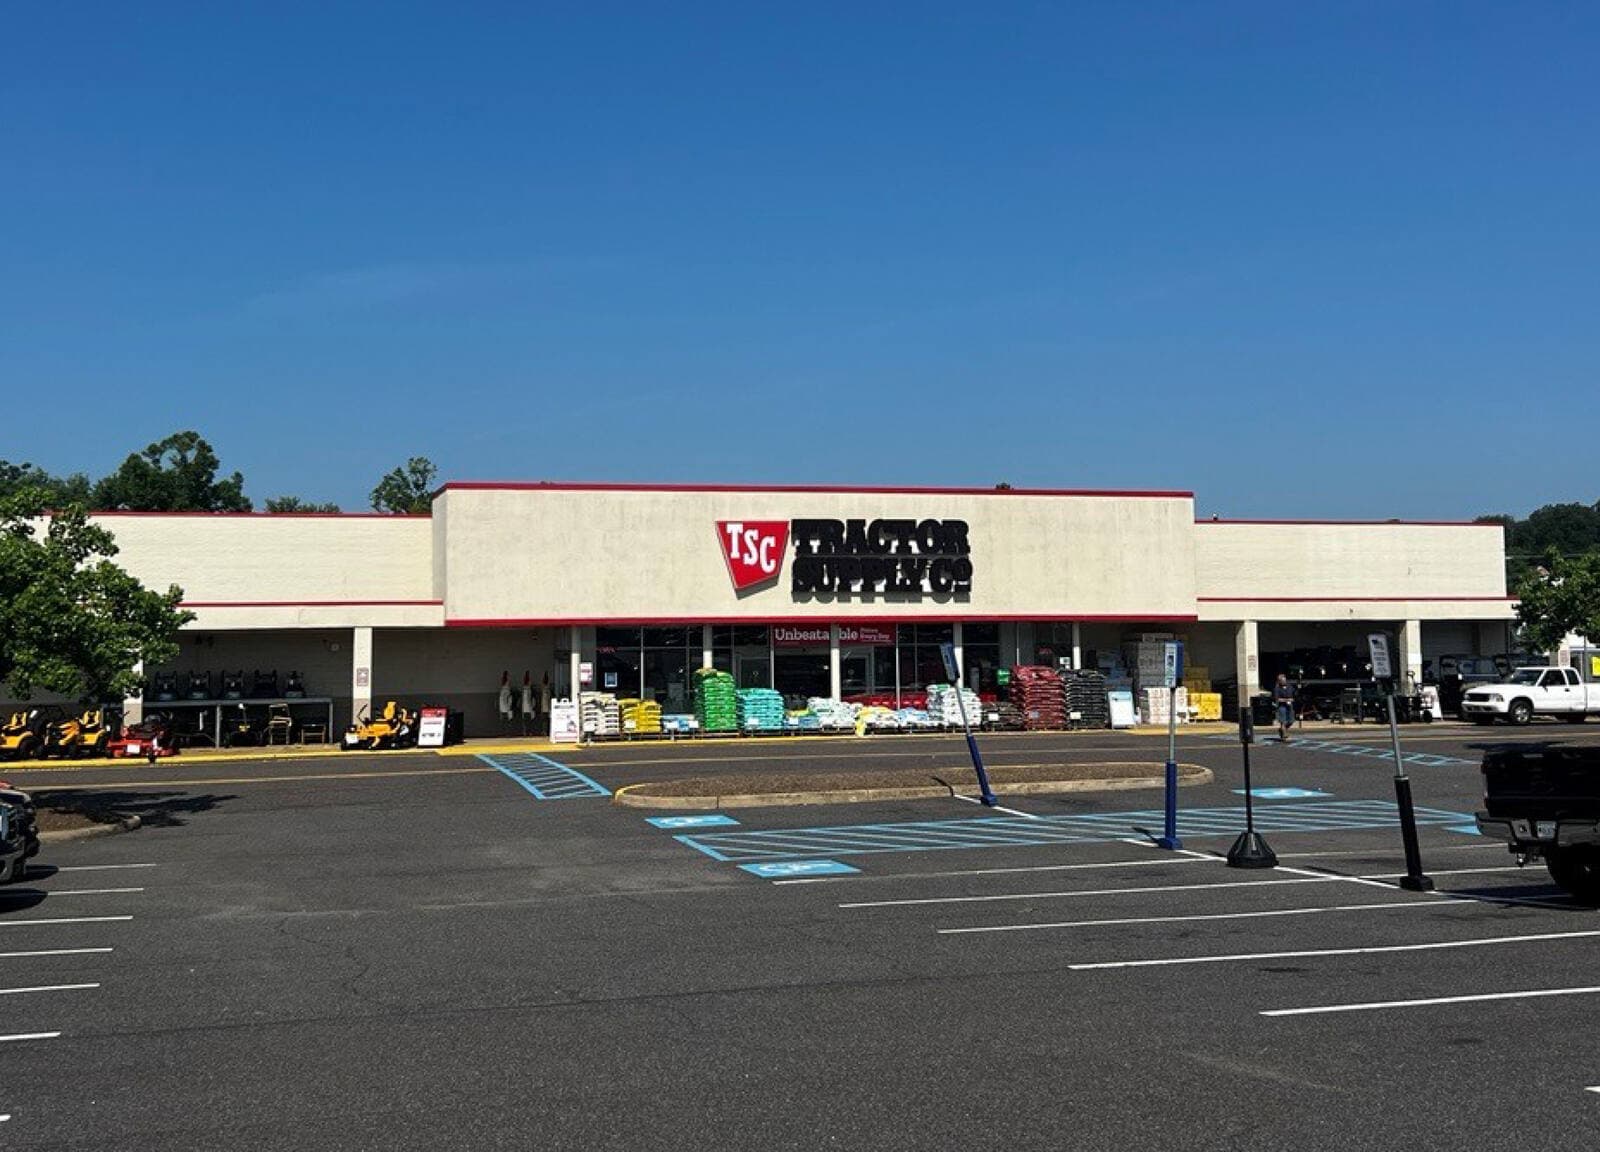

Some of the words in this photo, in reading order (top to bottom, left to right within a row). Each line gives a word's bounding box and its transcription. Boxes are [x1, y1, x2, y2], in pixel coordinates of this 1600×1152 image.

[726, 523, 777, 574] TSC
[791, 518, 971, 555] TRACTOR
[791, 558, 930, 601] SUPPLY
